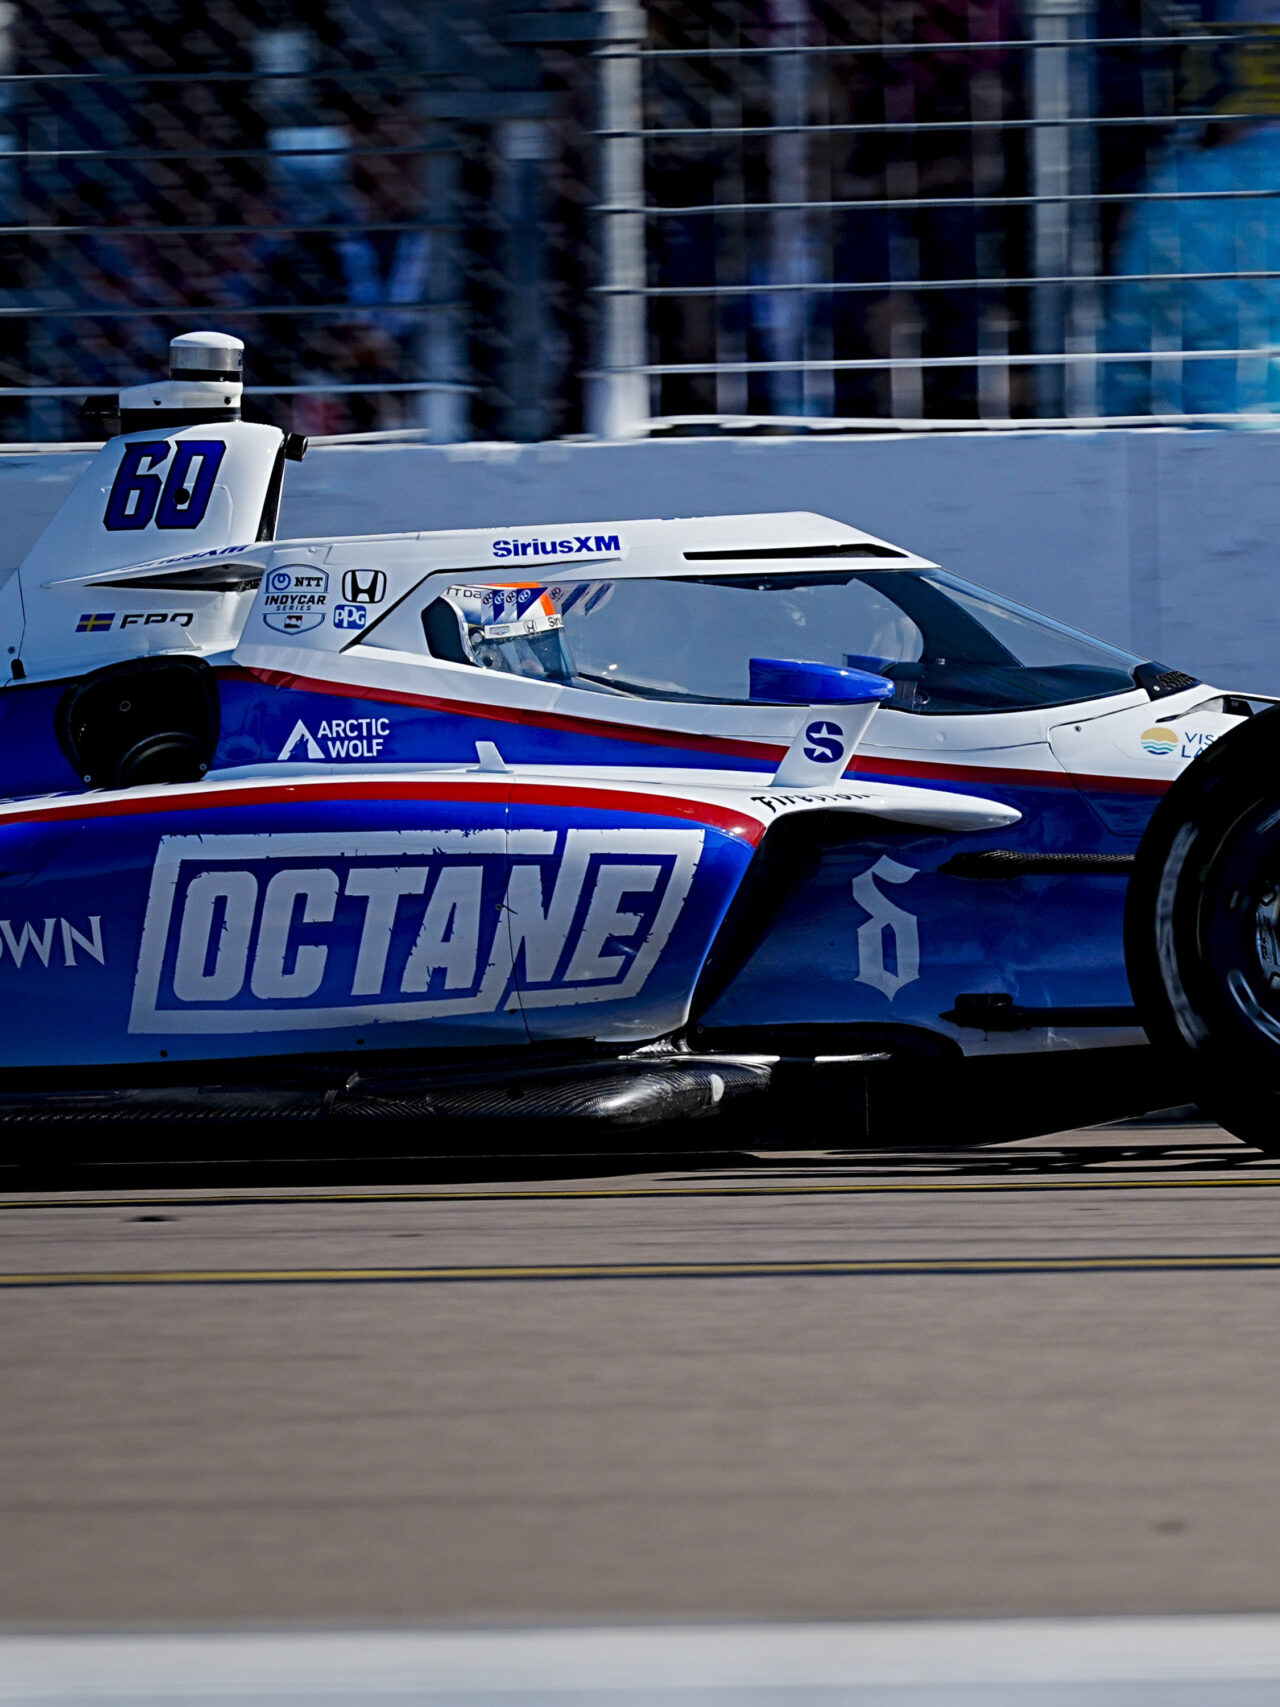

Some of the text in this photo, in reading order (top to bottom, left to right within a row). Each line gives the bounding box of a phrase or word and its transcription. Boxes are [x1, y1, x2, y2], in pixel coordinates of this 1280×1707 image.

[103, 440, 226, 532] 60
[492, 534, 622, 558] SiriusXM
[294, 576, 323, 587] NTT
[265, 594, 326, 606] INDYCAR
[335, 606, 366, 628] PPG
[317, 718, 390, 739] ARCTIC
[1184, 731, 1222, 747] VIS
[327, 738, 384, 758] WOLF
[0, 915, 105, 969] WN
[172, 862, 664, 1002] OCTANE
